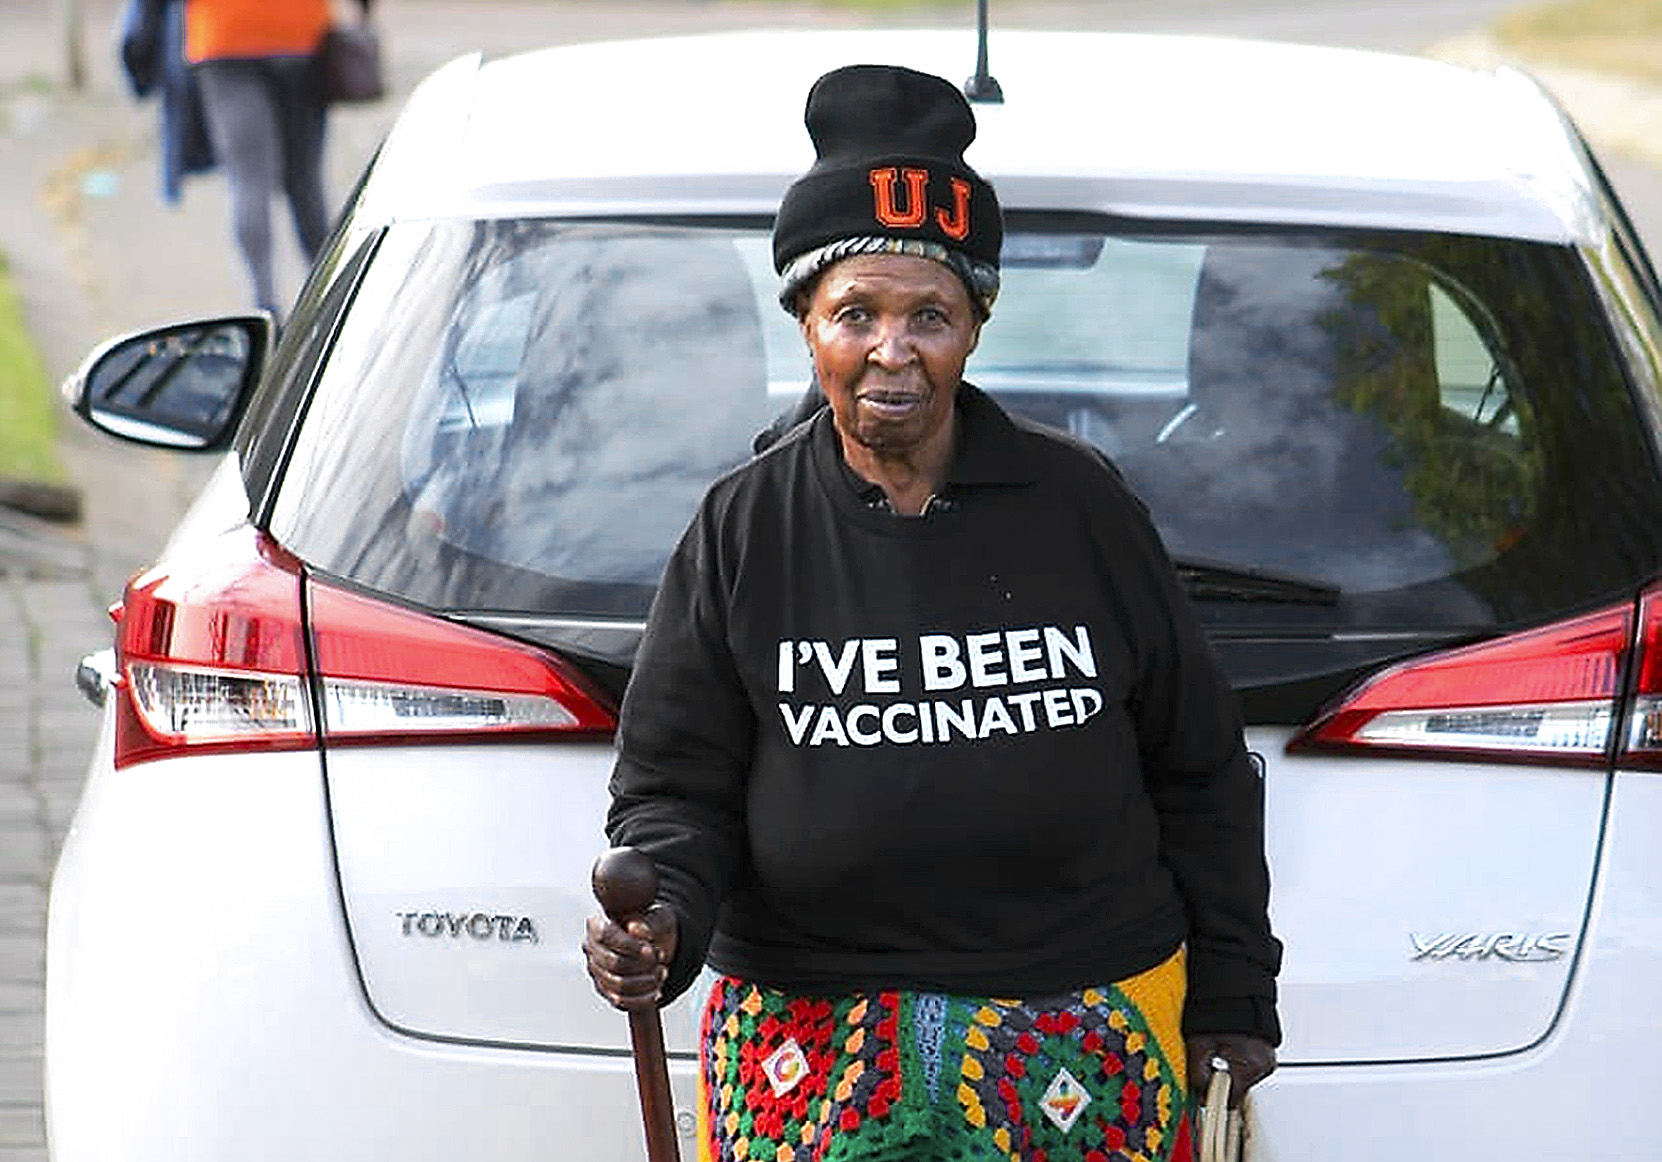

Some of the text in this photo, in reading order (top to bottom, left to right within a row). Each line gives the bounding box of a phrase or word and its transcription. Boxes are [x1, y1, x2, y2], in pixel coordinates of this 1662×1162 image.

[870, 168, 970, 240] UJ
[778, 626, 1098, 694] I'VE BEEN
[778, 688, 1104, 746] VACCINATED
[395, 909, 540, 945] TOYOTA
[1409, 932, 1571, 963] YARIS
